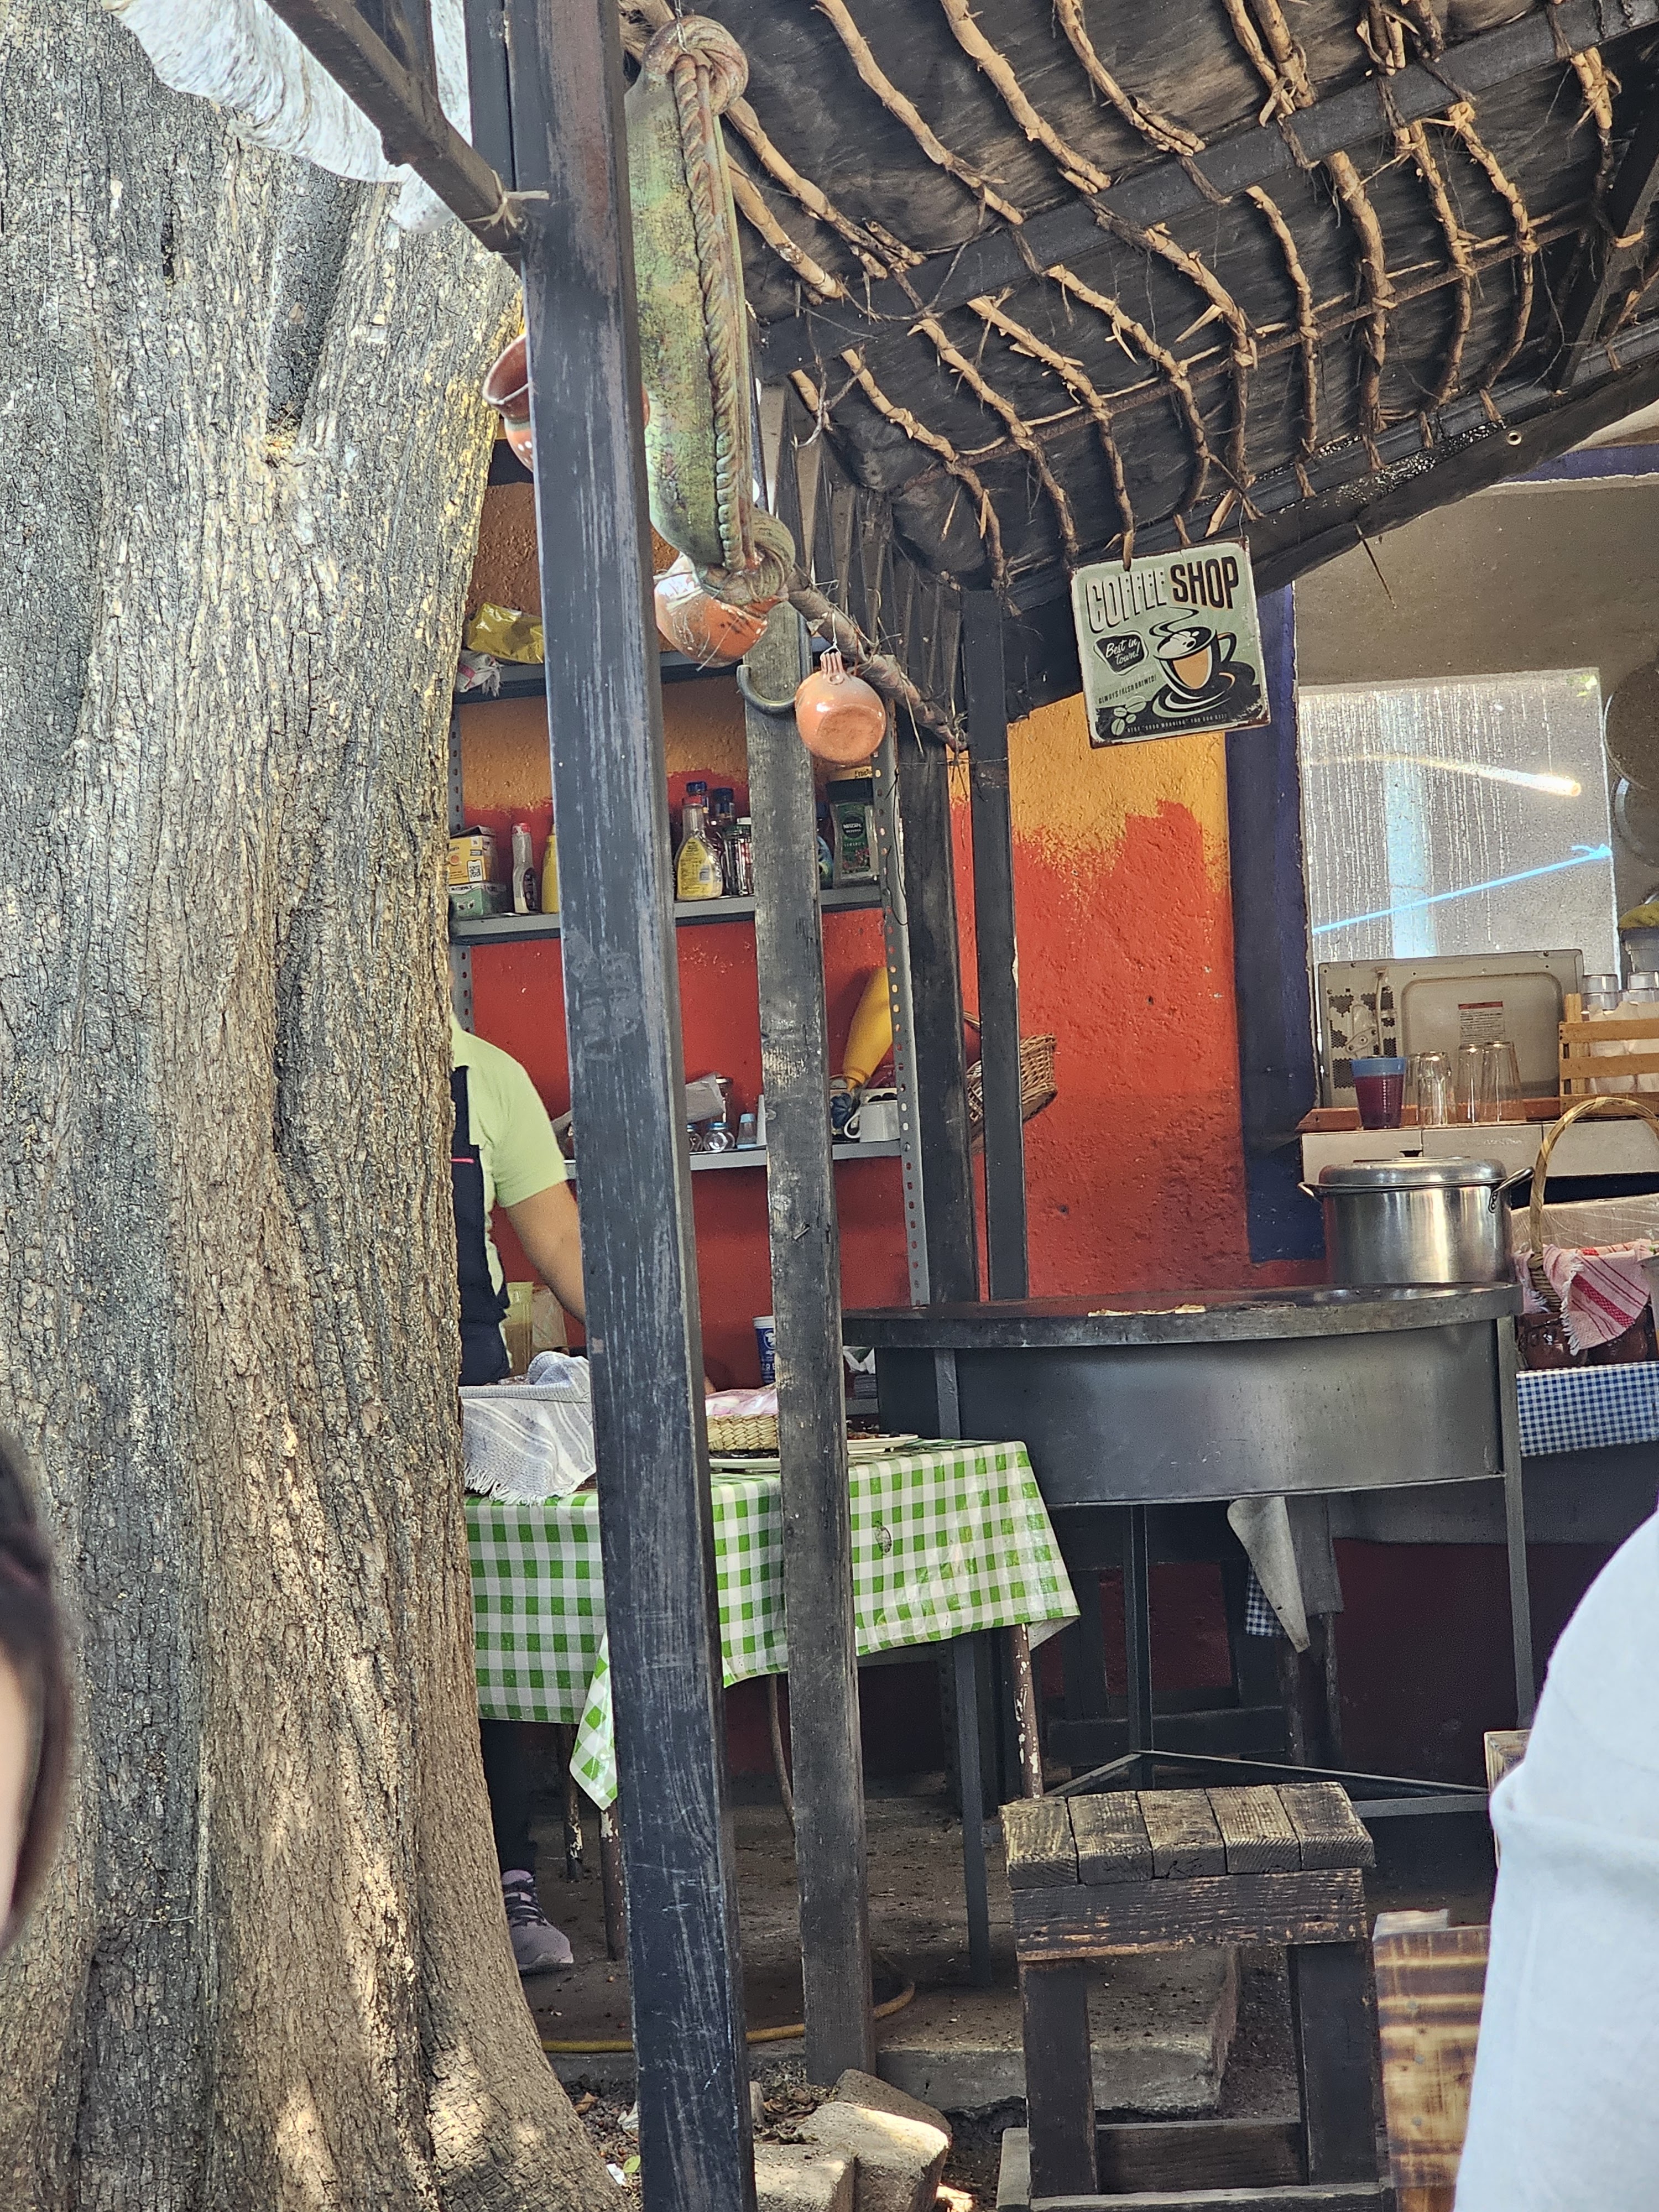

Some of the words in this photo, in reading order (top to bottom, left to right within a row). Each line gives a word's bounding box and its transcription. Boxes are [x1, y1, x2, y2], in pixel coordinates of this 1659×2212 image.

[1085, 566, 1168, 633] COFFEE
[1170, 556, 1239, 609] SHOP
[1106, 639, 1127, 658] Best
[1128, 638, 1138, 648] in
[1115, 641, 1140, 665] town!
